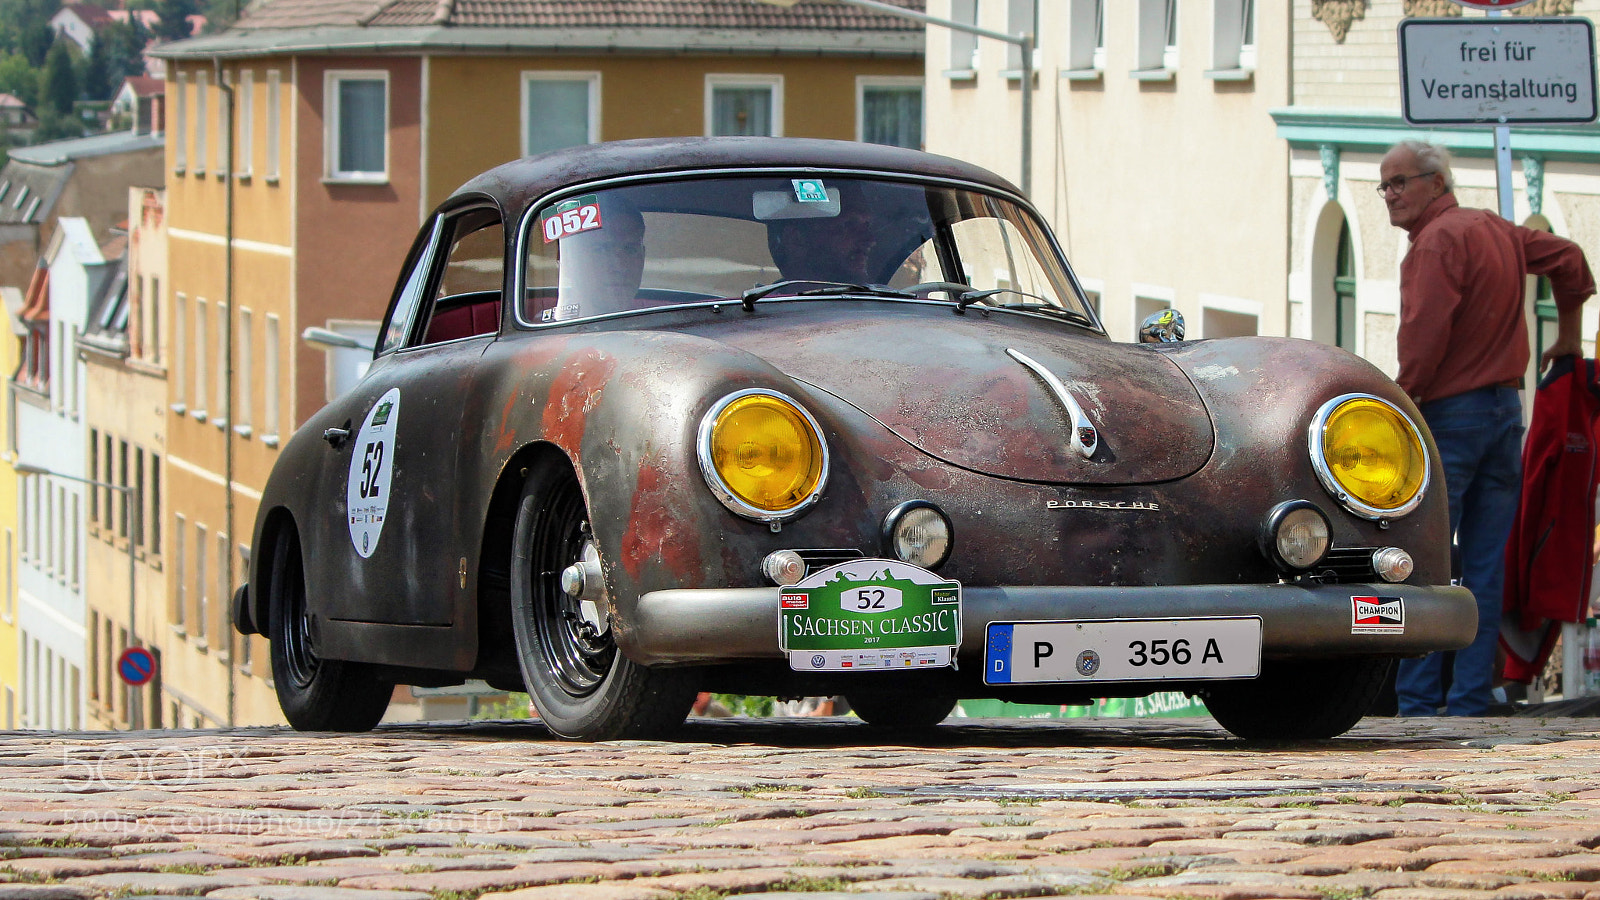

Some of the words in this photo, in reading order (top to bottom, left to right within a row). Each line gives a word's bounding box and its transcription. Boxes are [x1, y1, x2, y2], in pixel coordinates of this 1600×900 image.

[1460, 41, 1497, 62] frei
[1504, 41, 1536, 61] für
[1421, 78, 1577, 103] Veranstaltung
[545, 205, 599, 240] 052
[360, 440, 384, 499] 52
[1046, 500, 1160, 511] PORSCHE
[857, 589, 885, 609] 52
[1358, 606, 1399, 615] CHAMPION
[793, 614, 874, 637] SACHSEN
[879, 609, 949, 634] CLASSIC
[863, 636, 880, 644] 2017
[1033, 641, 1054, 668] P
[1127, 639, 1192, 667] 356
[1201, 638, 1224, 664] A
[994, 660, 1004, 672] D
